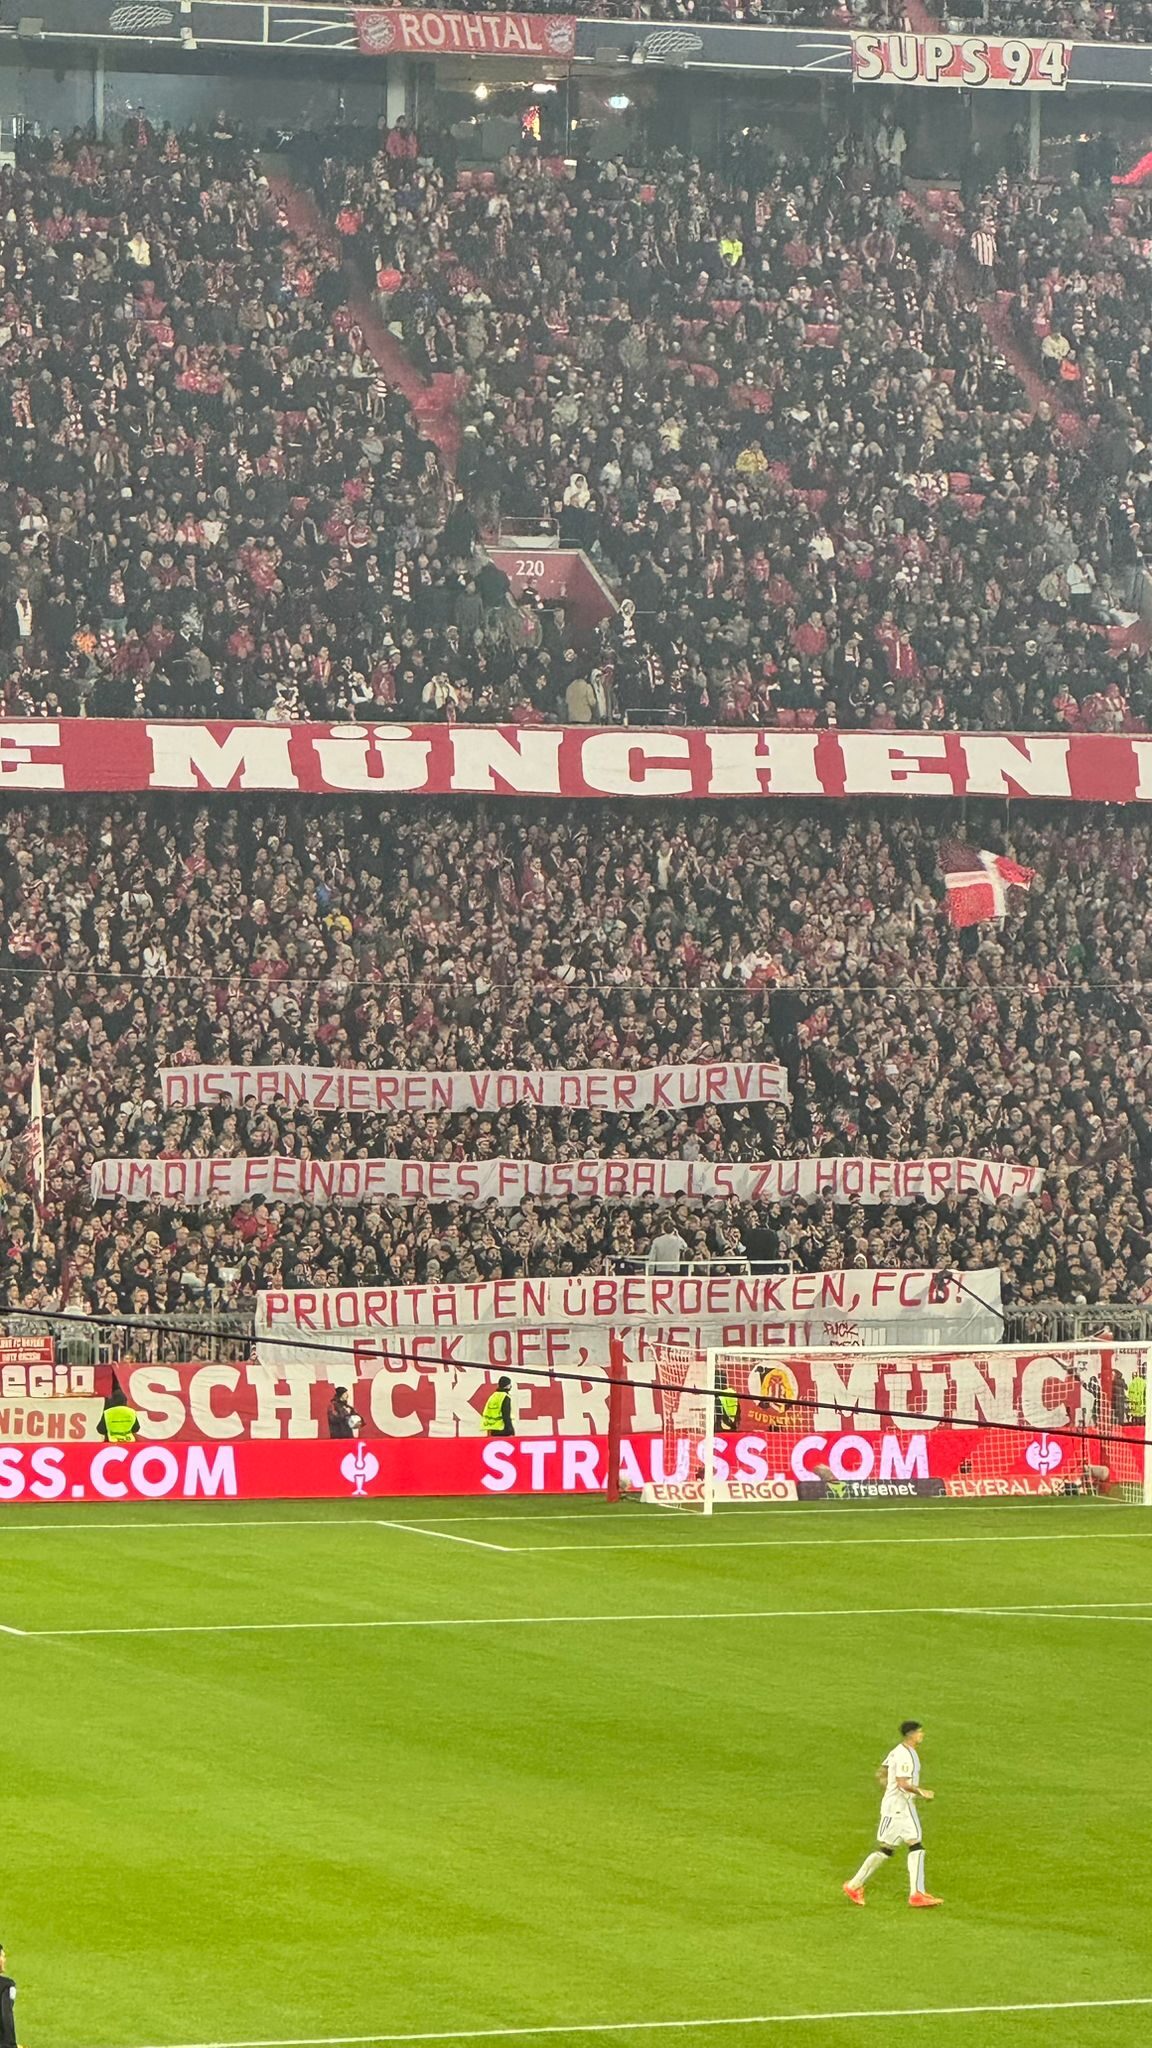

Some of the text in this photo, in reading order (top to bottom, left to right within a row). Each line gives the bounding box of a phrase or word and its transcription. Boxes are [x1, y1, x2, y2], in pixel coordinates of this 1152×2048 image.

[399, 13, 542, 50] ROTHTAL
[855, 35, 1067, 86] SUPS 94
[516, 560, 545, 576] 220
[146, 724, 1072, 797] MÜNCHEN
[166, 1065, 780, 1110] DISTANZIEREN VON DER KURVE
[102, 1161, 152, 1196] UM
[164, 1160, 231, 1198] DIE
[244, 1157, 386, 1197] FEINDE
[401, 1162, 480, 1198] DES
[499, 1161, 734, 1198] FUSSBALLS
[750, 1161, 800, 1199] ZU
[266, 1272, 963, 1330] PRIORITÄTEN ÜBERDENKEN, FCB!
[353, 1334, 467, 1377] FUCK
[488, 1327, 588, 1368] OFF,
[0, 1446, 237, 1498] SS.COM
[481, 1433, 930, 1492] STRAUSS.COM
[728, 1482, 789, 1499] ERGO
[852, 1482, 917, 1497] freenet
[950, 1478, 1086, 1497] FLYERALAR
